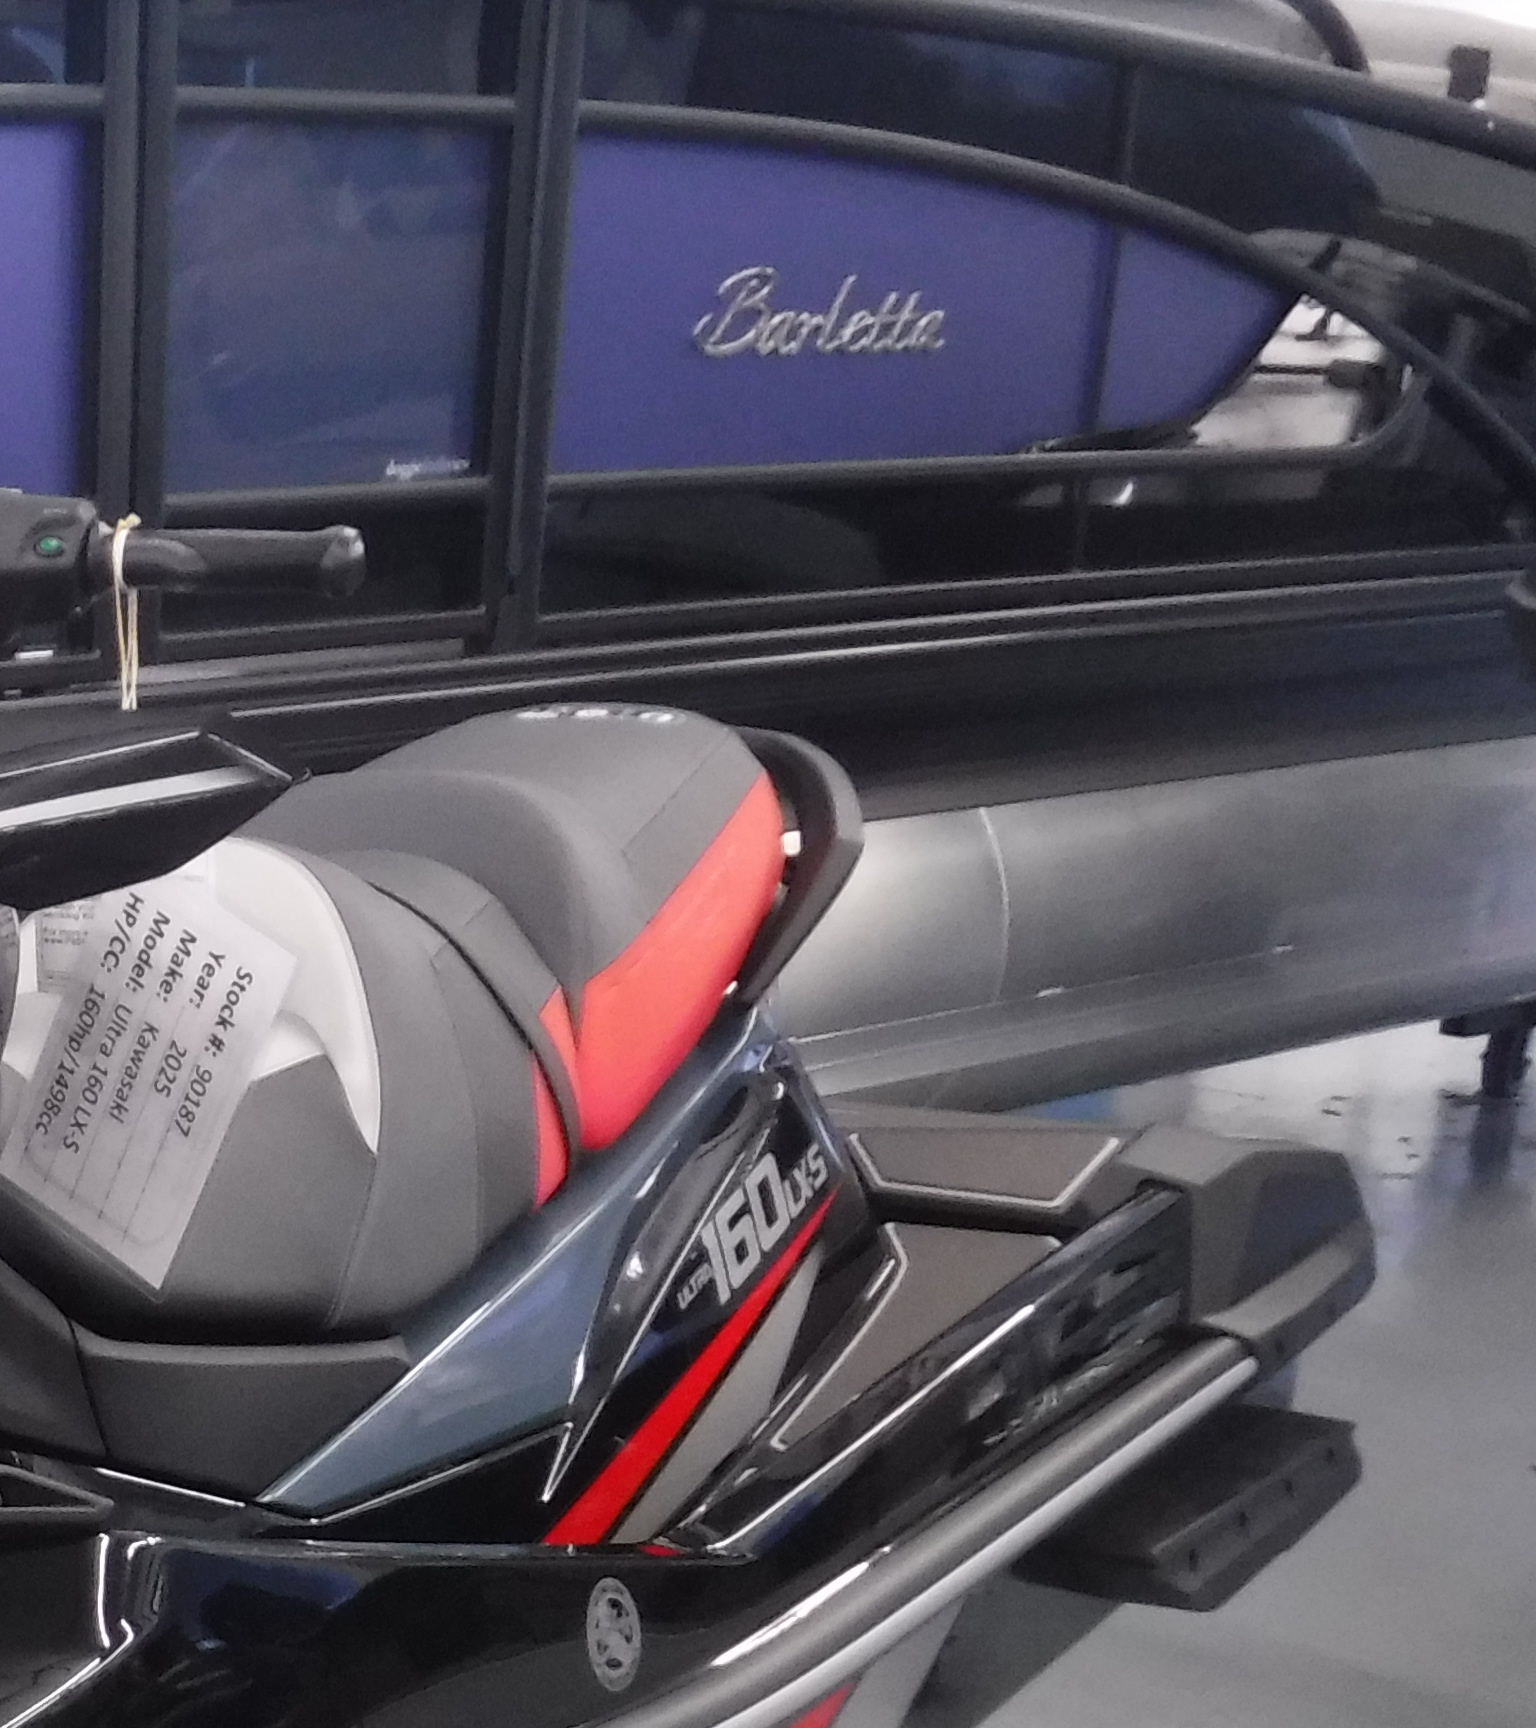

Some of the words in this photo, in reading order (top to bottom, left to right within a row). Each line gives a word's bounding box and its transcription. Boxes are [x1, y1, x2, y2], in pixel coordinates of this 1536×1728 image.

[693, 266, 945, 356] Barletta
[100, 891, 145, 974] HP/CC:
[125, 910, 171, 993] Model:
[156, 929, 198, 1003] Make:
[189, 950, 226, 1009] Year:
[215, 966, 254, 1033] Stock
[35, 982, 106, 1135] 160hp/1498cc
[99, 1003, 133, 1059] Ultra
[81, 1063, 109, 1106] 160
[109, 1021, 159, 1124] Kawasaki
[154, 1039, 188, 1098] 2025
[174, 1064, 213, 1138] 90187
[63, 1104, 92, 1153] LX-S
[700, 1152, 791, 1306] 160
[783, 1143, 829, 1219] LX-S
